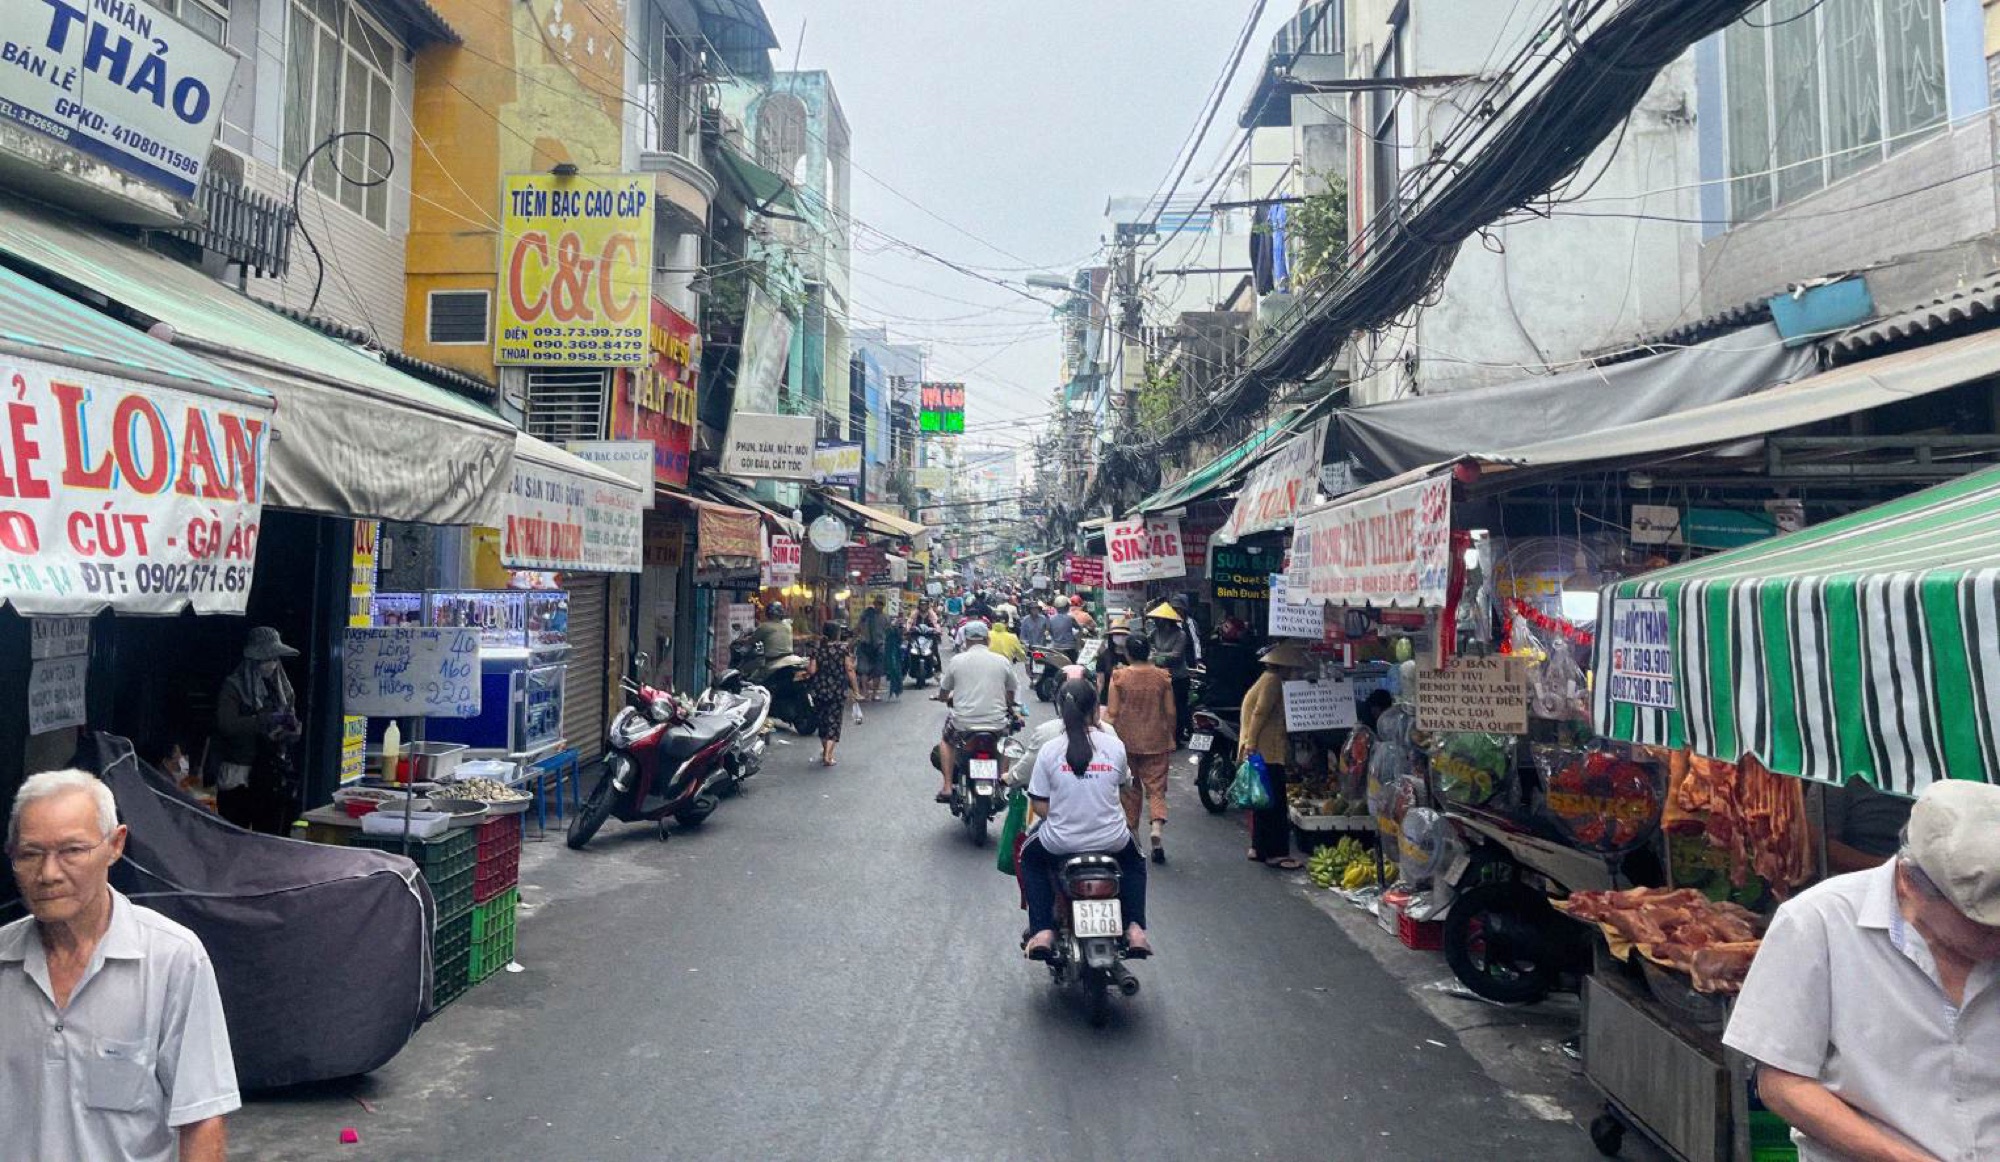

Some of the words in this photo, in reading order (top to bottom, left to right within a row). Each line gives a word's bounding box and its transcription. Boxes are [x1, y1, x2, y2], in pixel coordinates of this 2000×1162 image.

[93, 0, 152, 39] NHÂN
[42, 0, 211, 125] THẢO
[50, 66, 77, 92] LẺ
[0, 102, 18, 118] EL:
[55, 98, 107, 135] GPKD:
[511, 183, 547, 223] TIỆM
[551, 190, 581, 223] BẠC
[585, 190, 613, 217] CAO
[617, 180, 647, 217] CẤP
[509, 231, 638, 323] C&C
[0, 374, 50, 499] Ẻ
[50, 380, 266, 504] LOAN
[67, 501, 150, 557] CÚT
[187, 508, 222, 561] GÀ
[79, 562, 129, 595] ĐT:
[1420, 706, 1438, 716] PIN
